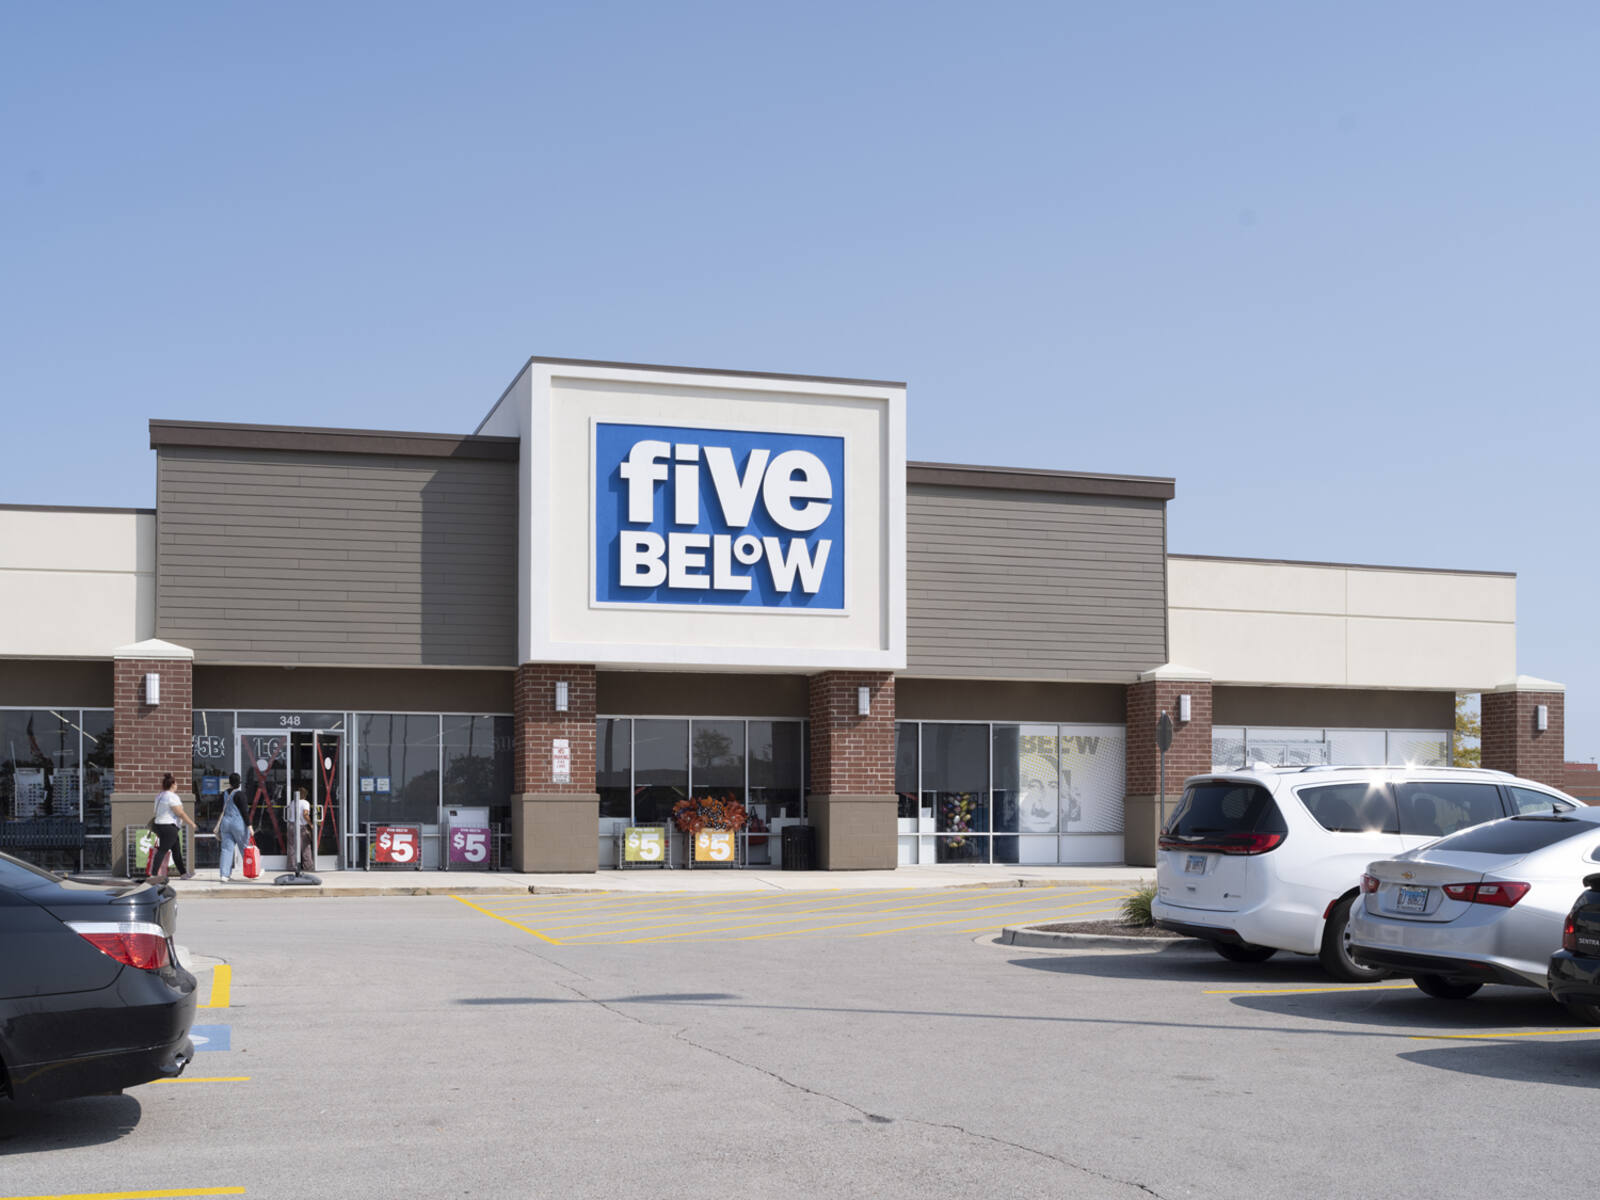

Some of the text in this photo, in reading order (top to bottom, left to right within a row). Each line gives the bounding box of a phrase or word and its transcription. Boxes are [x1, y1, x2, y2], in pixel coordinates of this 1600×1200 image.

[620, 440, 832, 532] five
[620, 530, 832, 594] BELOW
[280, 715, 301, 726] 348
[379, 832, 414, 862] $5
[453, 832, 487, 862] $5
[628, 832, 661, 861] $5
[698, 832, 731, 860] $5
